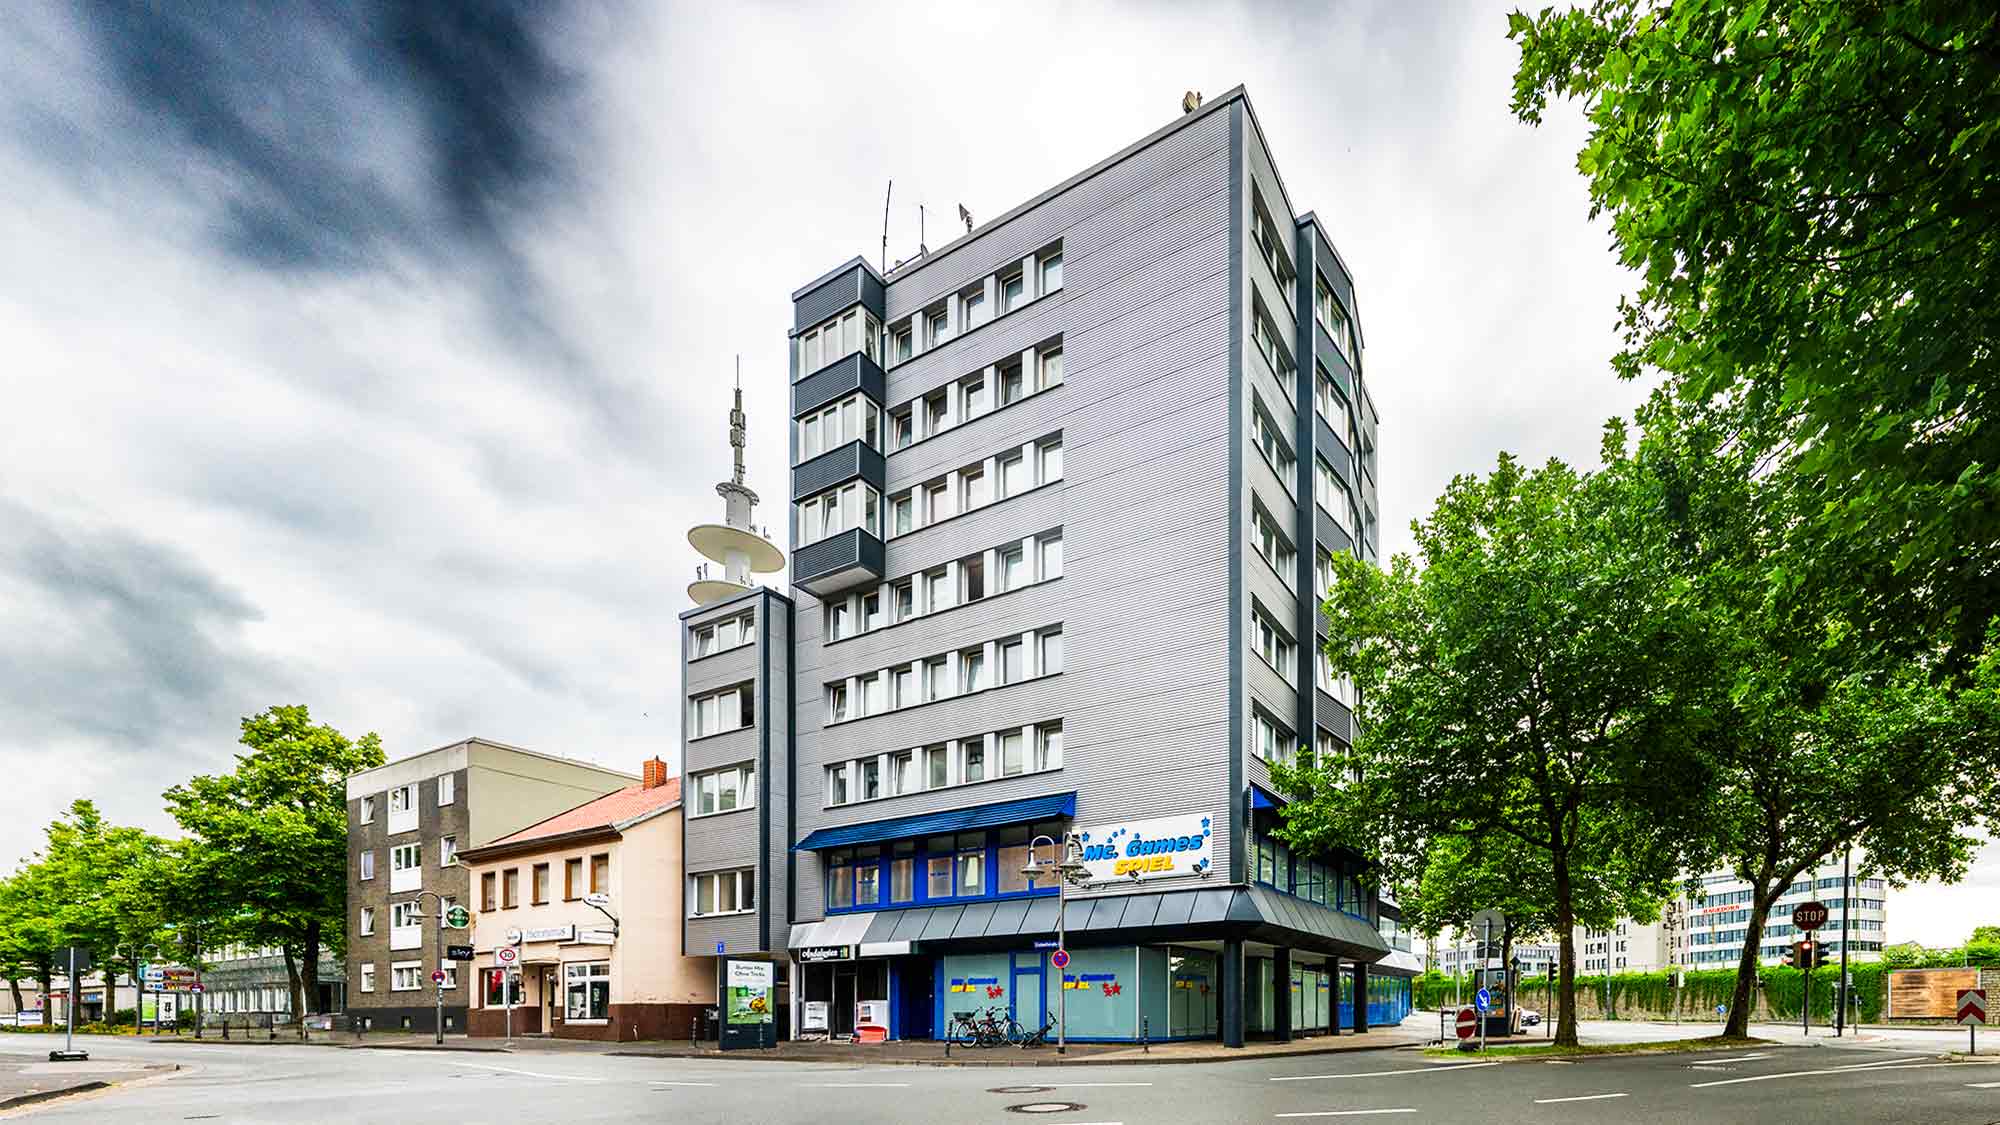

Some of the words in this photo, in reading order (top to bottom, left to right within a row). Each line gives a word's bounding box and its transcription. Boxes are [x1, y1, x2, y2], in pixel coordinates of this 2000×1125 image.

[1126, 834, 1204, 857] Games
[1113, 855, 1175, 876] SPIEL
[1796, 910, 1825, 922] STOP
